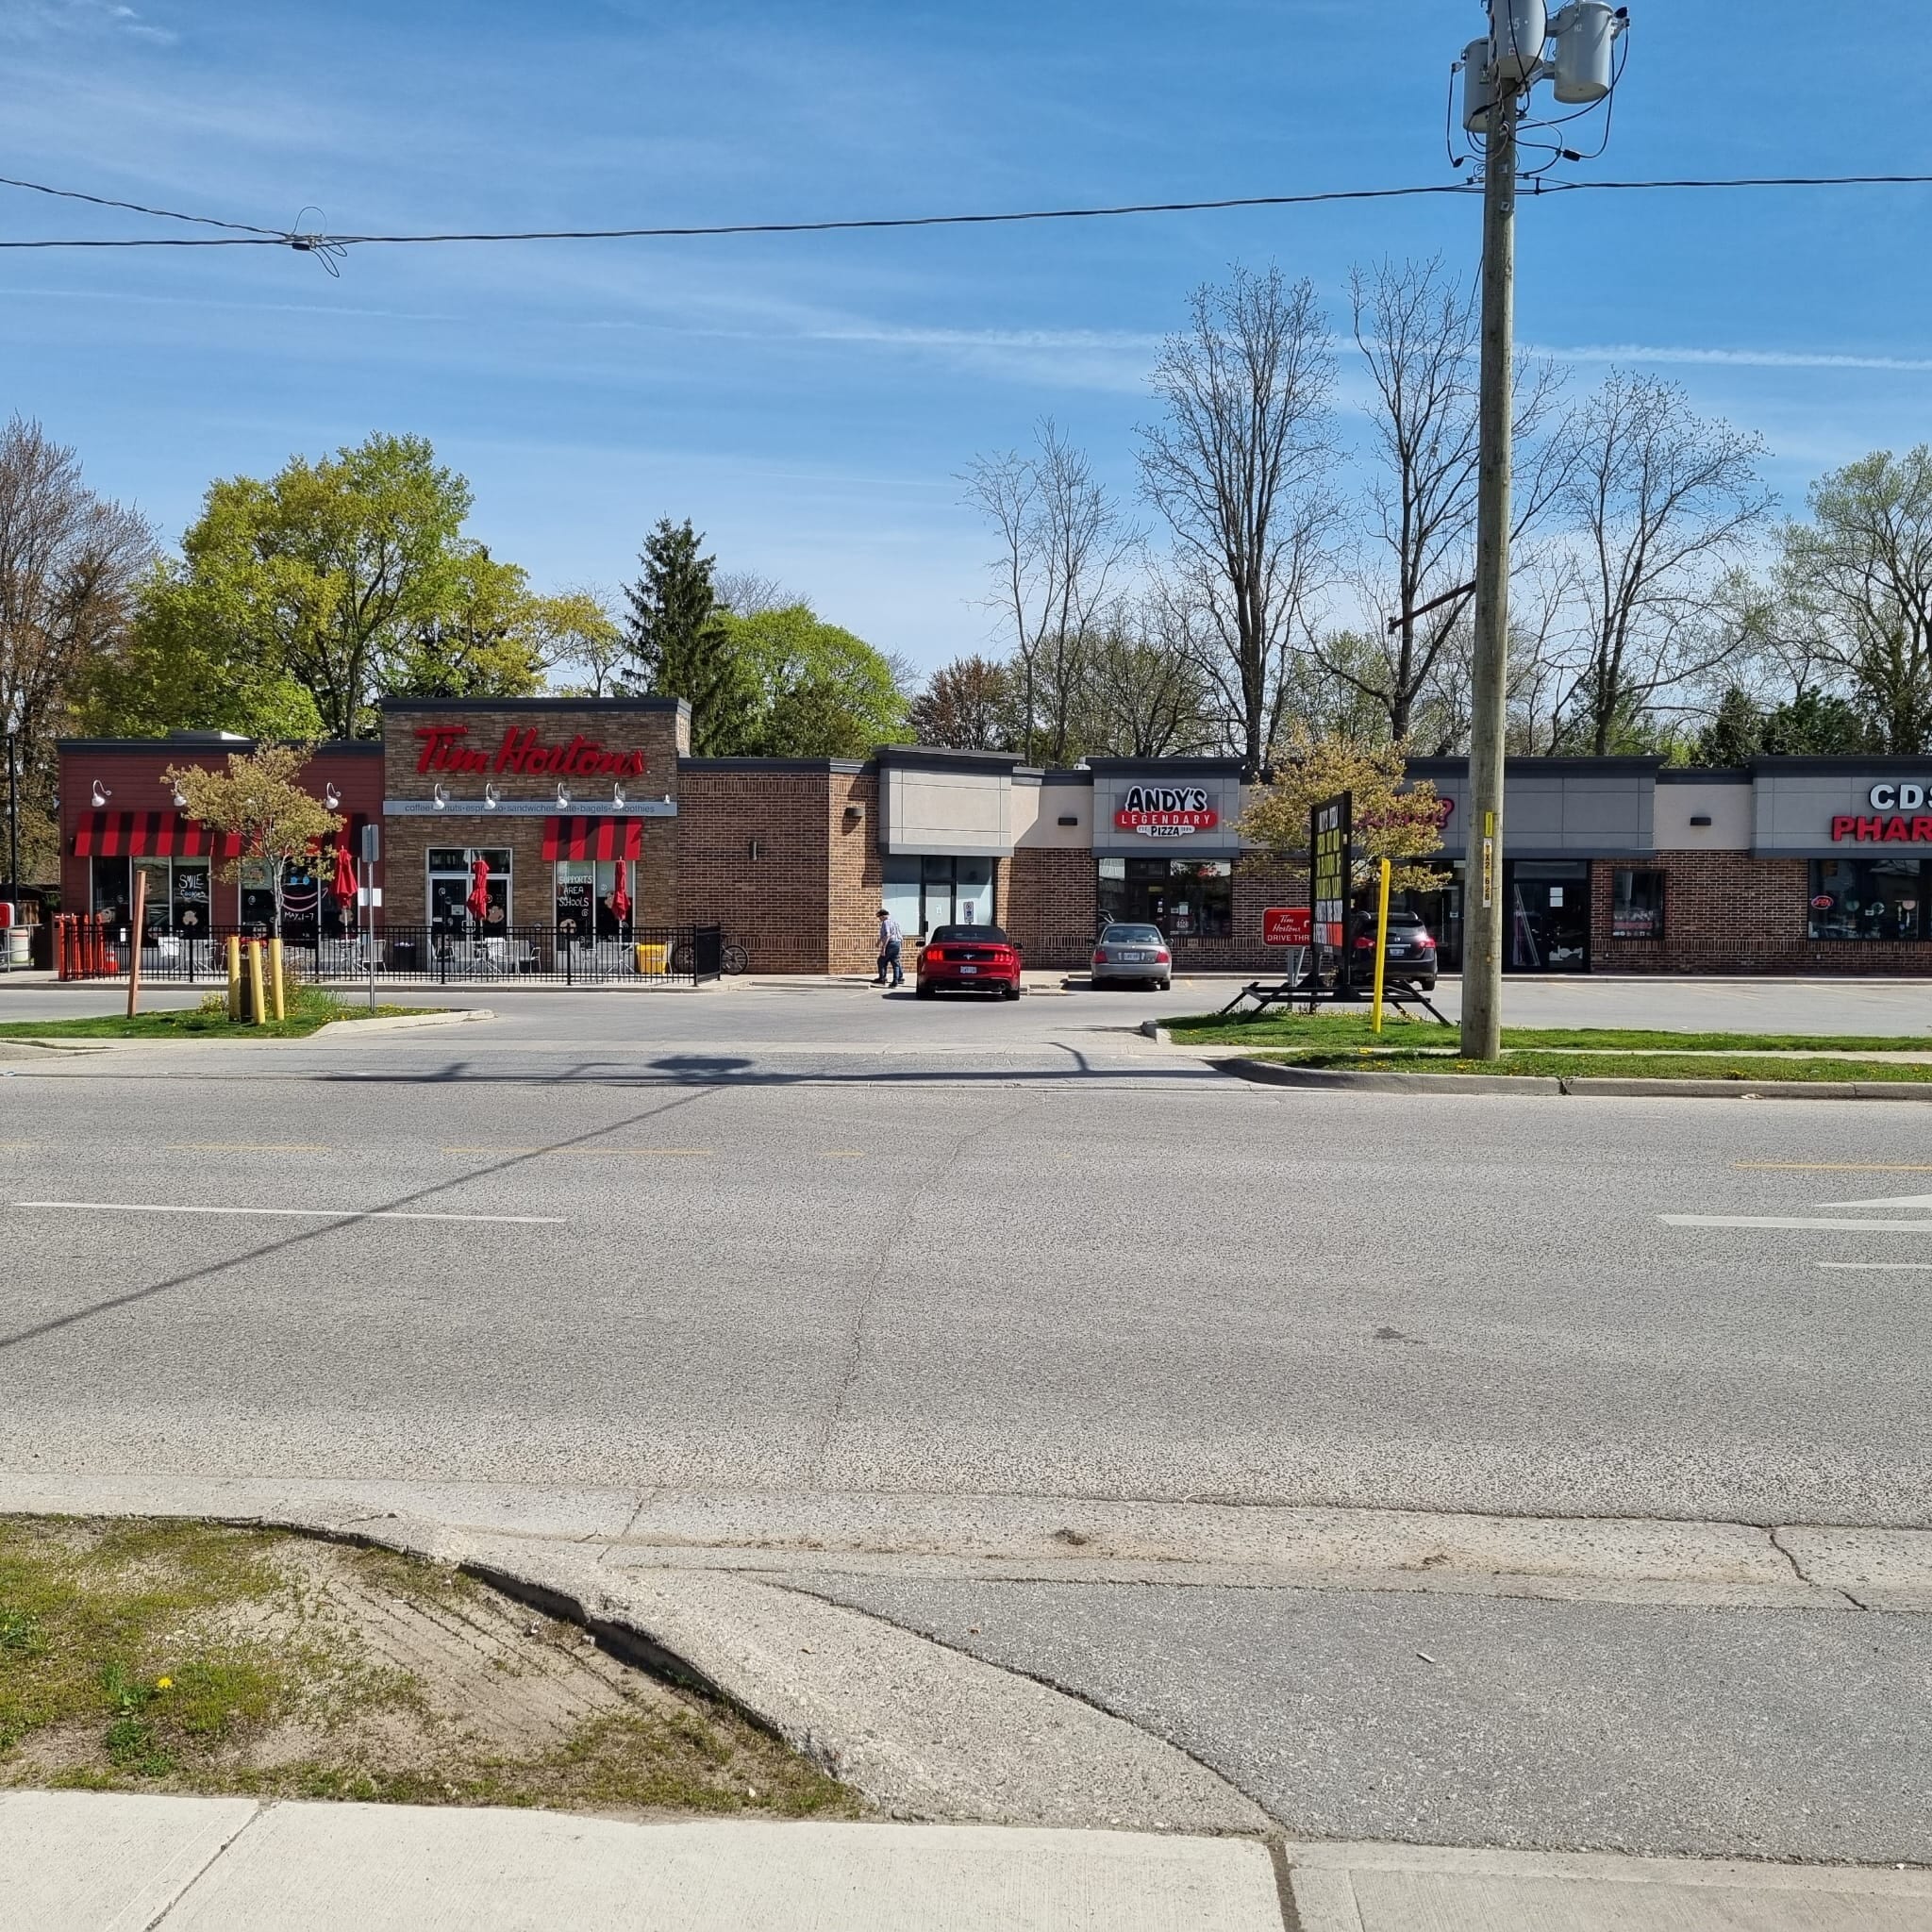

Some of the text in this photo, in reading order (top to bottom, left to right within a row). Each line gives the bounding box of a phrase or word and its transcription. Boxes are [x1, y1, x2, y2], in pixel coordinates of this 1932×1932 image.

[414, 724, 644, 775] Tim Hortons
[1126, 787, 1207, 812] ANDY'S
[1870, 784, 1932, 809] CD
[1121, 814, 1210, 824] LEGENDARY
[1151, 825, 1180, 836] PIZZA
[563, 886, 584, 895] AREA
[1279, 914, 1294, 924] Tim
[1272, 923, 1301, 932] Hortons
